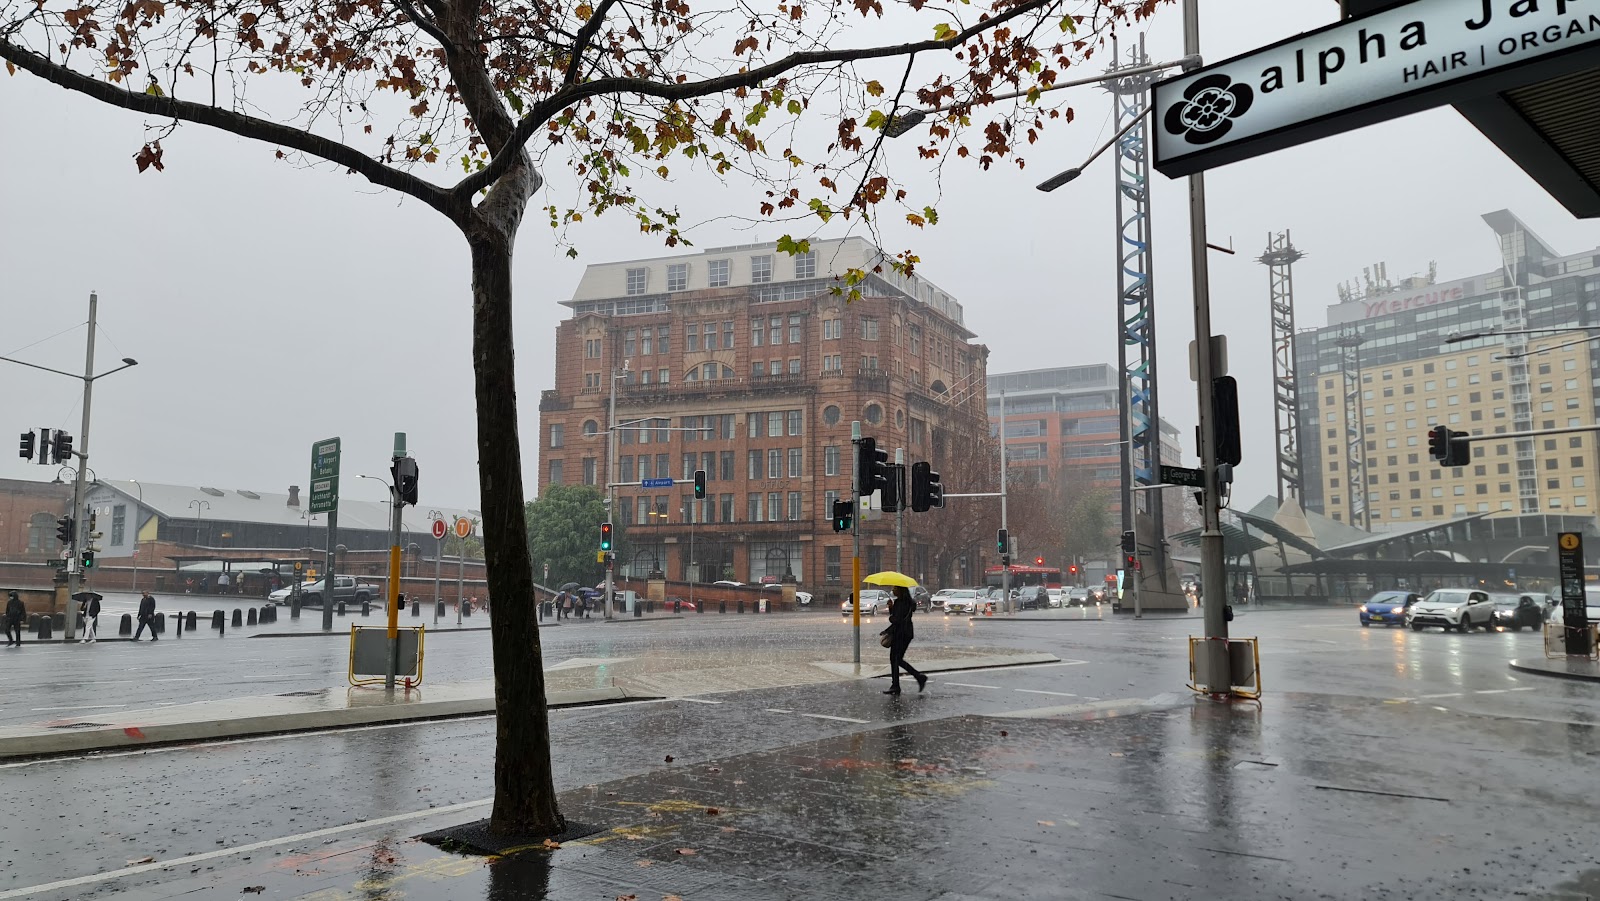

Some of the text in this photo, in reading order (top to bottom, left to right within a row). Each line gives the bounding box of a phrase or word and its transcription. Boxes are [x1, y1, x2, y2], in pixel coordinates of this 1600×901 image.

[1260, 21, 1427, 93] alpha
[1403, 51, 1468, 83] HAIR
[1361, 287, 1464, 318] Mercure
[323, 456, 337, 464] Airport
[1171, 469, 1197, 481] George St
[760, 480, 790, 489] OFFICE
[436, 523, 441, 534] L
[460, 523, 466, 534] T
